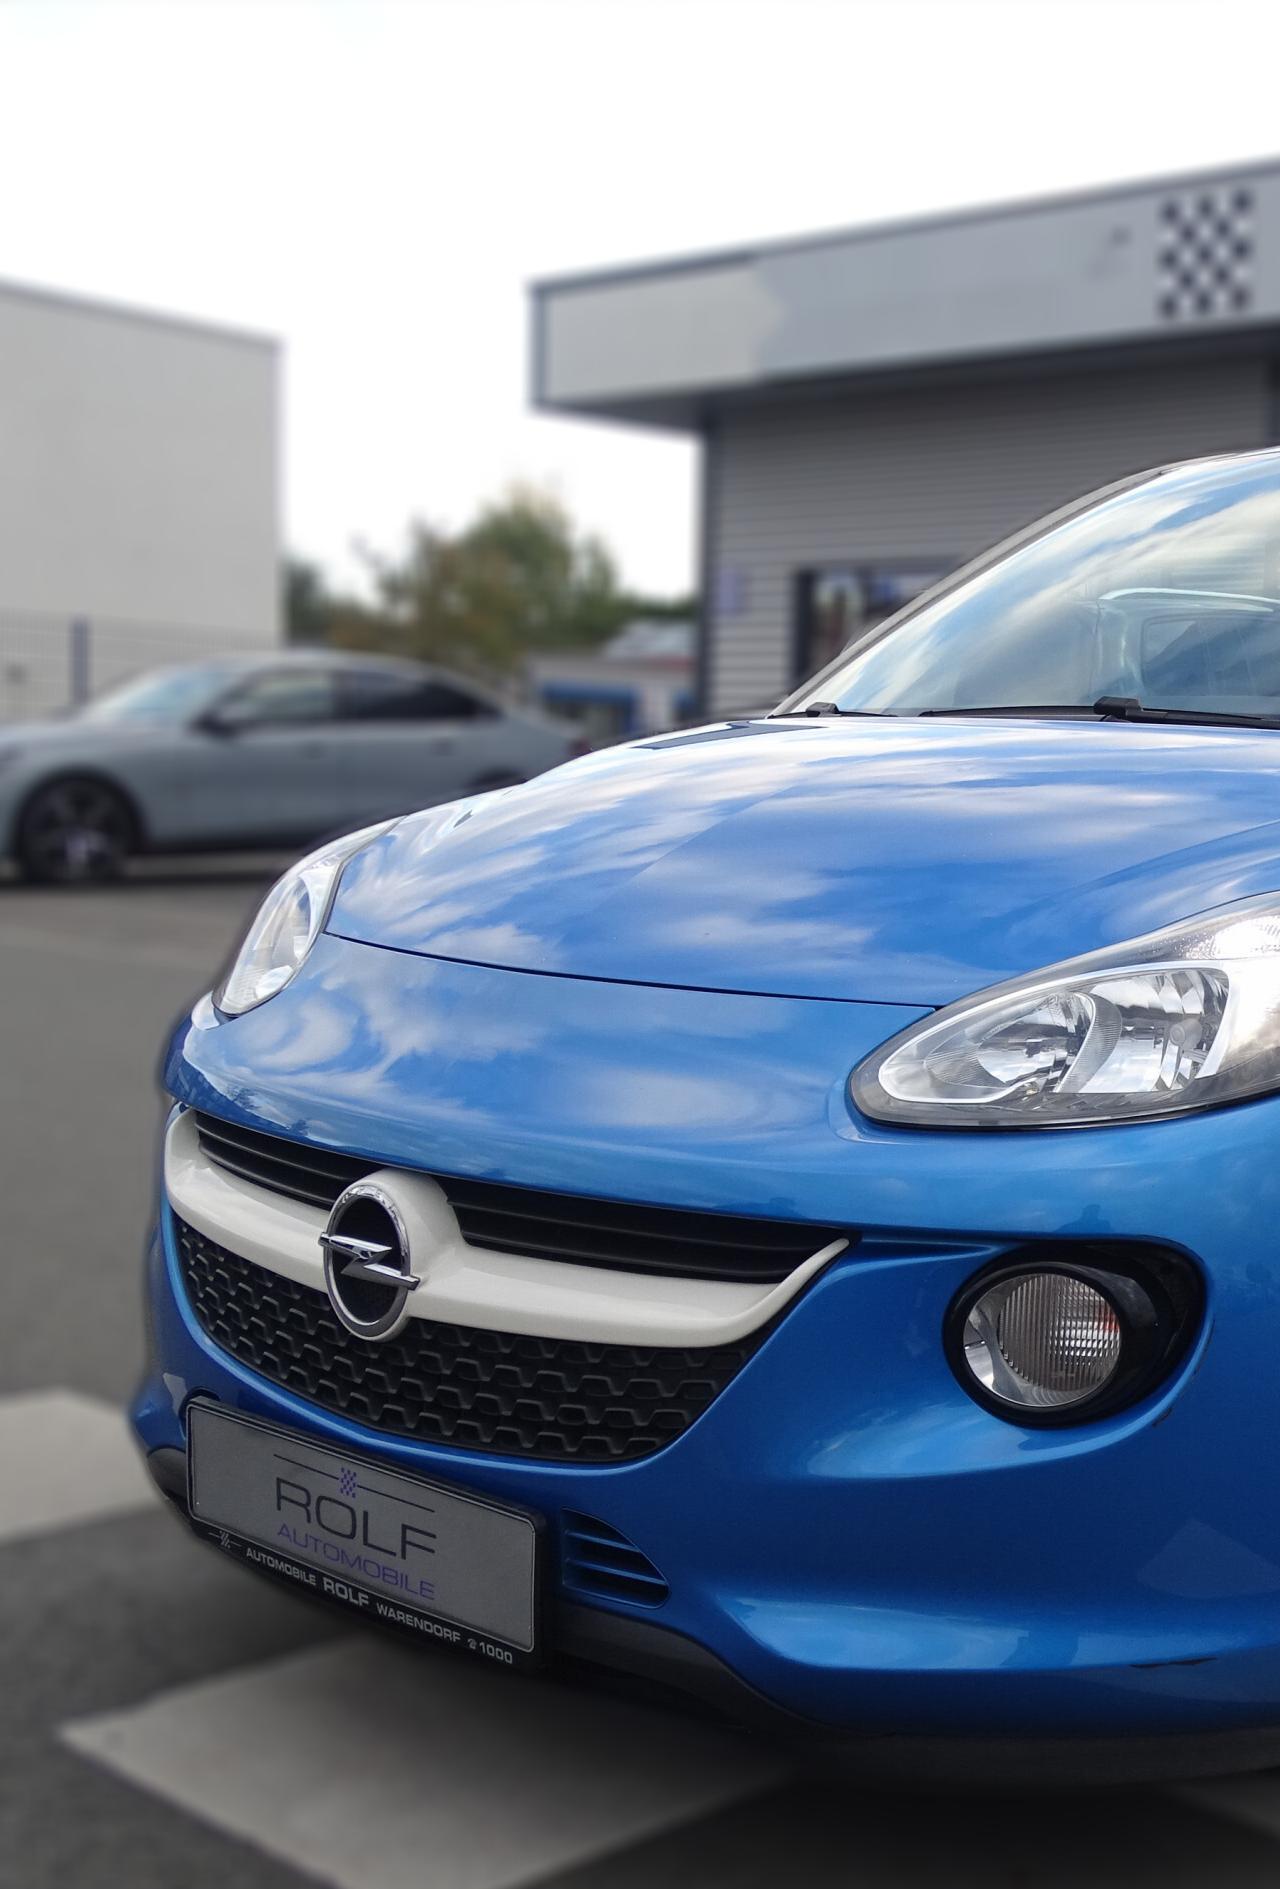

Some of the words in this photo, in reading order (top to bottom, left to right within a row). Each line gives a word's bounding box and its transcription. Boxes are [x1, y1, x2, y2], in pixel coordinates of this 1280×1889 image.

[276, 1477, 437, 1560] ROLF
[246, 1548, 317, 1585] AUTOMOBILE
[323, 1577, 369, 1606] ROLF
[376, 1602, 461, 1642] WARENDORF
[278, 1523, 435, 1600] AUTOMOBILE
